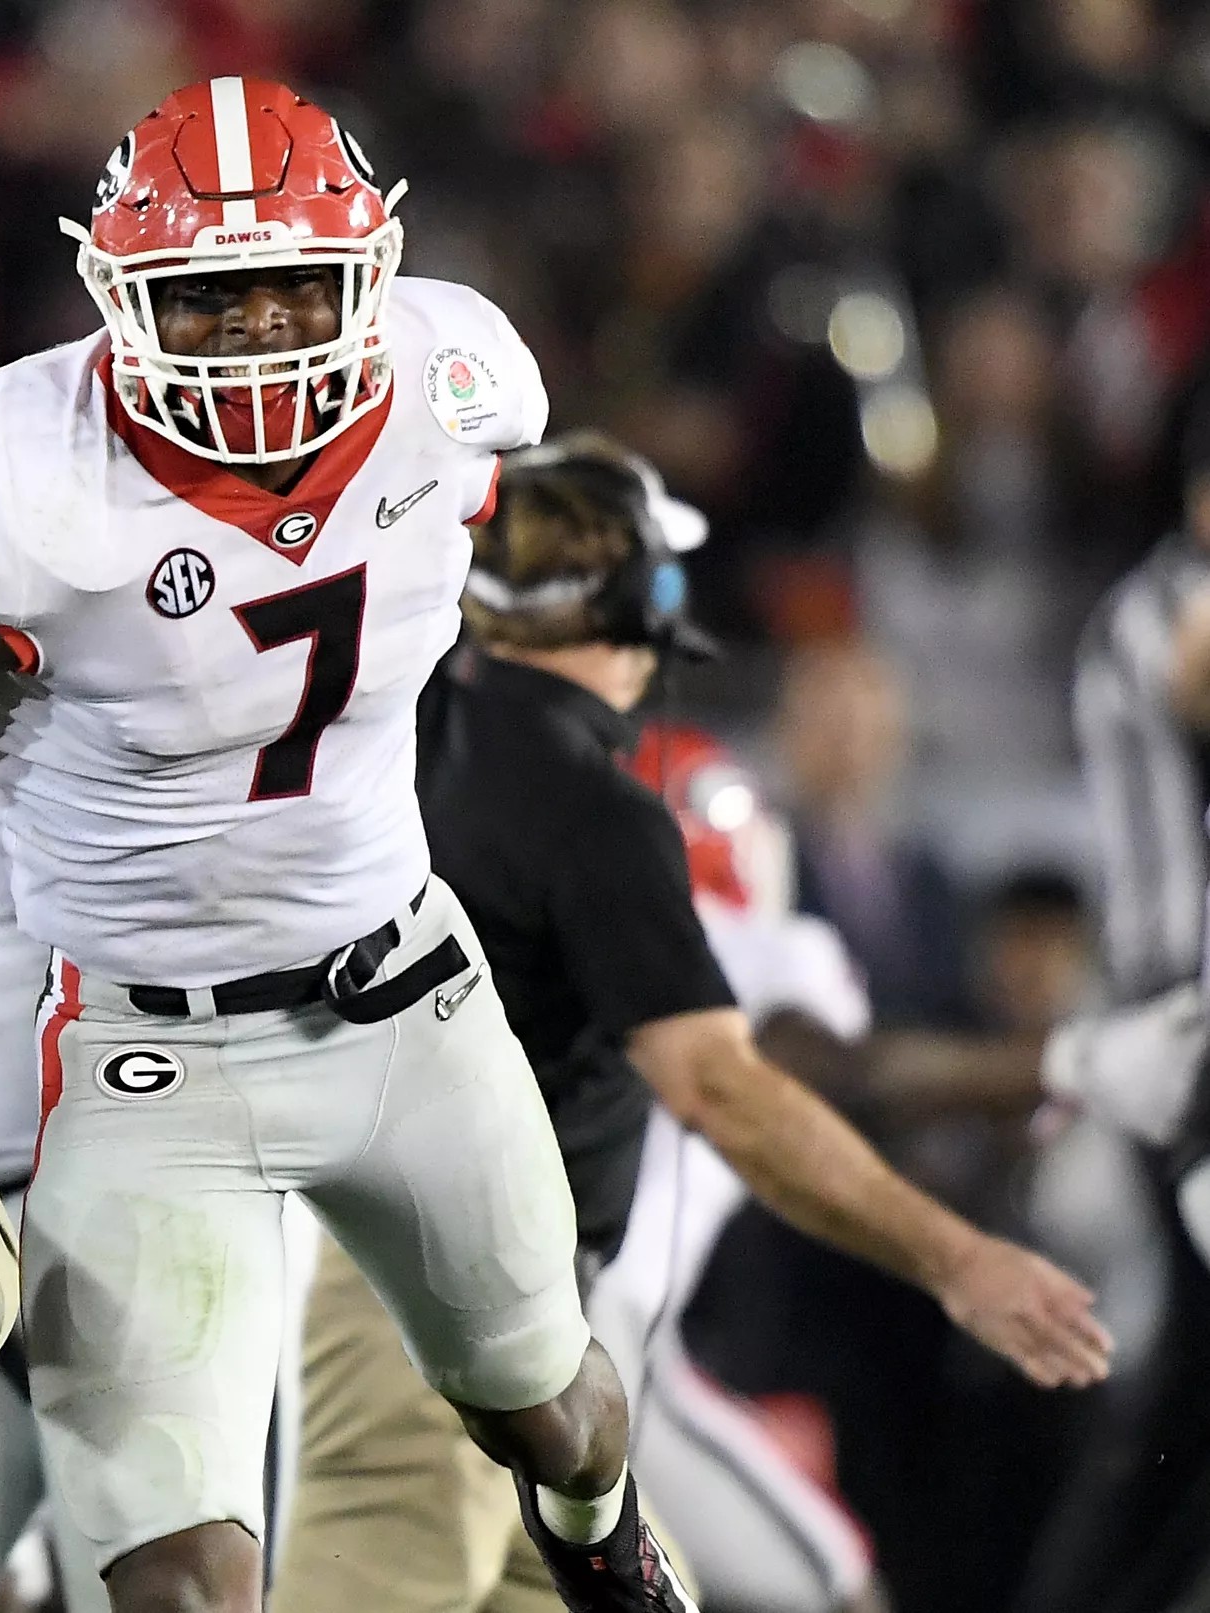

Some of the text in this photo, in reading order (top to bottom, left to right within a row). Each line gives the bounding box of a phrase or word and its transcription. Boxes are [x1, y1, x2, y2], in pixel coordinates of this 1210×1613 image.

[215, 231, 272, 245] DAWGS
[427, 364, 439, 402] ROSE
[435, 347, 467, 363] BOWL
[274, 513, 316, 547] G
[152, 552, 211, 614] SEC
[230, 561, 367, 802] 7
[99, 1048, 180, 1097] G
